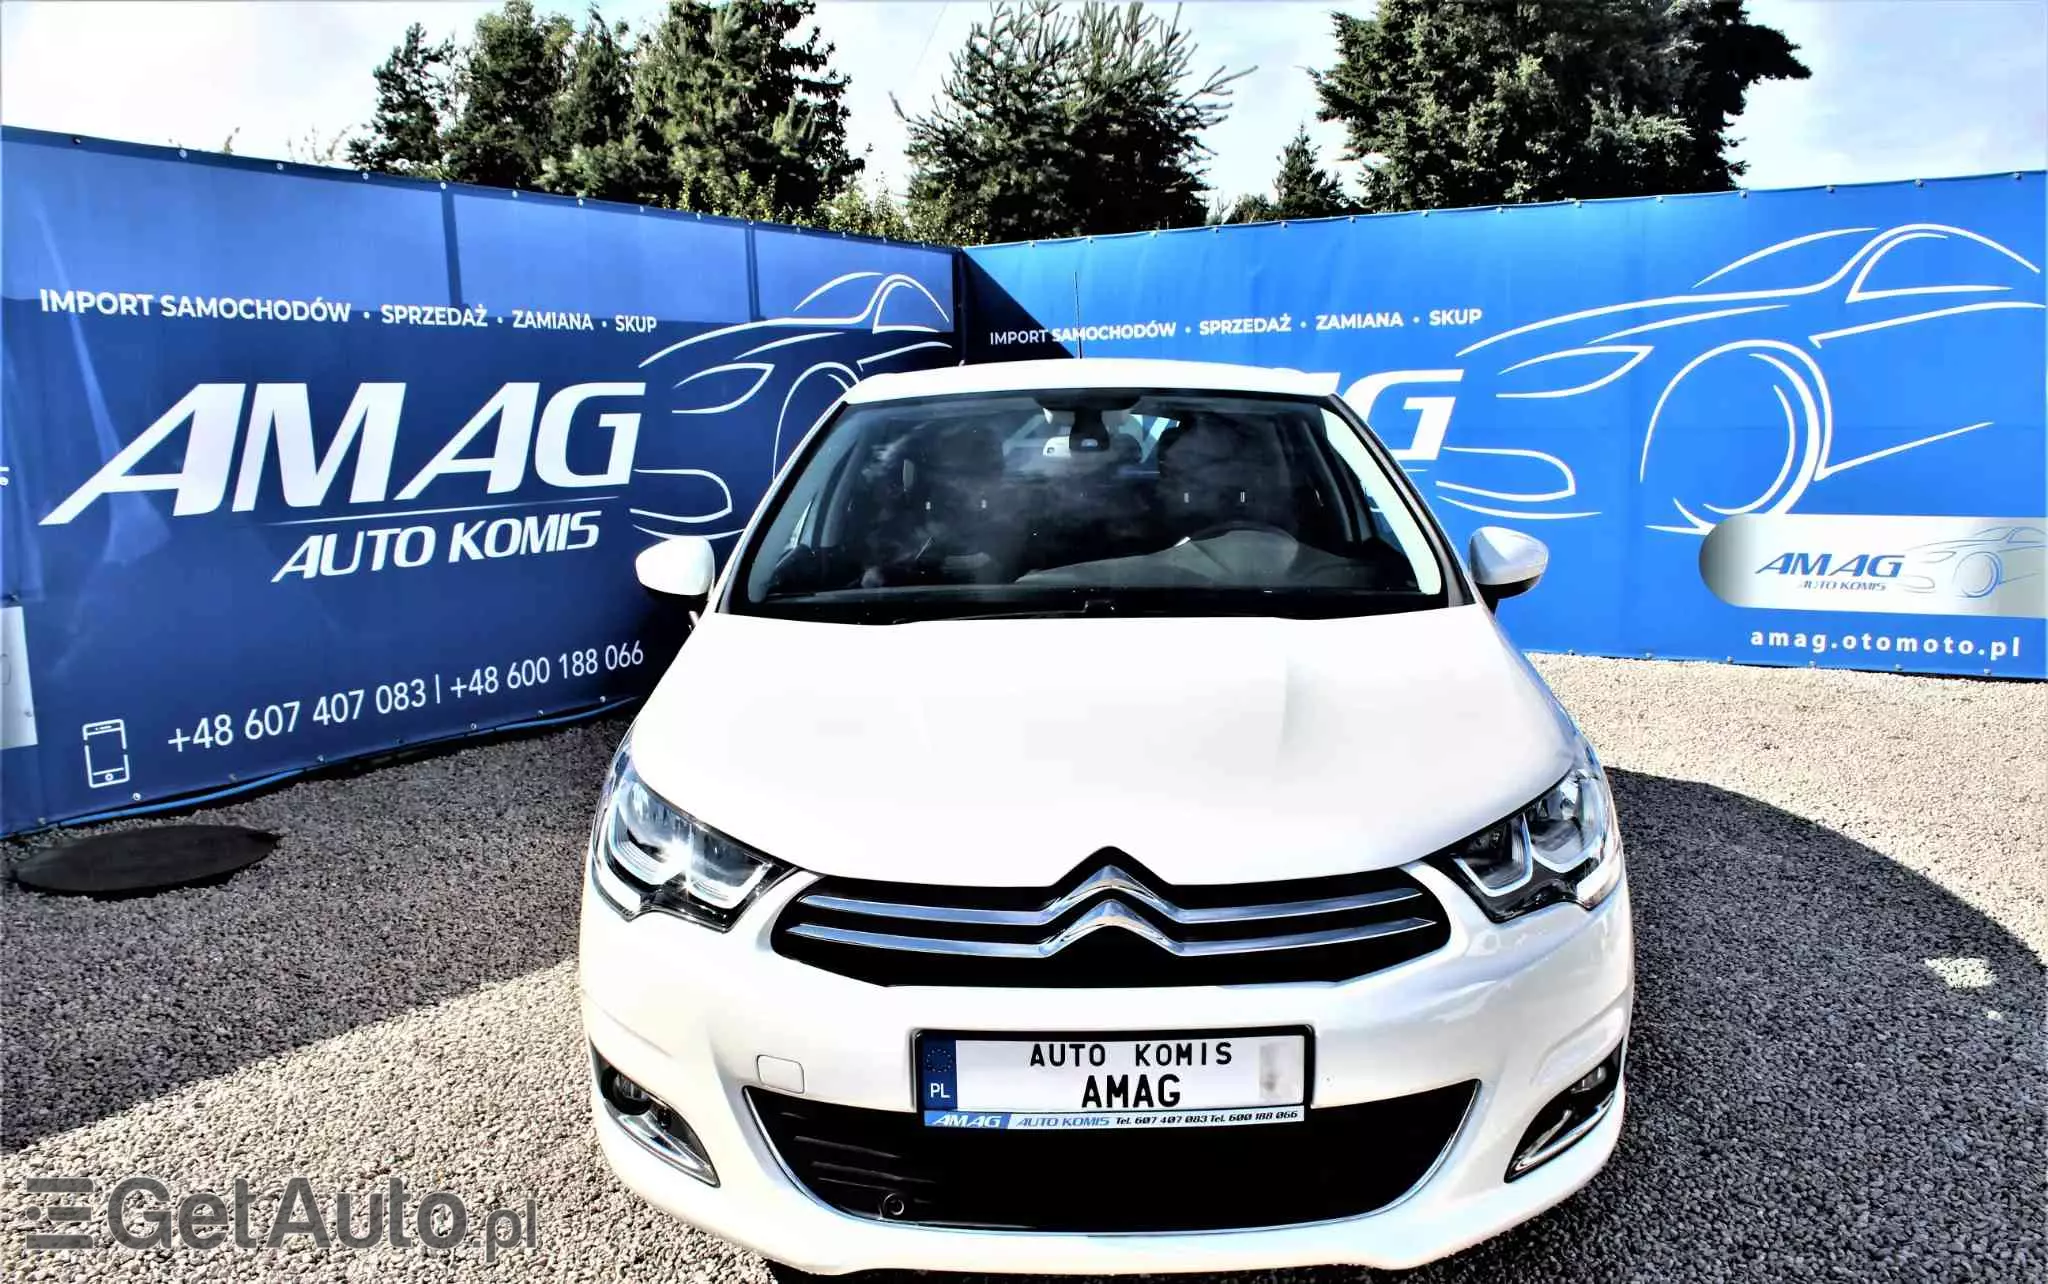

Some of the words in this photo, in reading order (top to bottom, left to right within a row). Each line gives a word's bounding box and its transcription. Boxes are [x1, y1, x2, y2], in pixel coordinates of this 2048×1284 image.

[40, 289, 154, 316] IMPORT
[161, 295, 350, 323] SAMOCHODÓW
[380, 303, 488, 327] SPRZEDAŻ
[512, 310, 594, 331] ZAMIANA
[615, 314, 658, 333] SKUP
[990, 329, 1048, 345] IMPORT
[1051, 320, 1177, 342] SAMOCHODÓW
[1199, 312, 1291, 336] SPRZEDAŻ
[1315, 312, 1404, 330] ZAMIANA
[1429, 308, 1483, 326] SKUP
[272, 522, 435, 583] AUTO
[448, 510, 602, 563] KOMIS
[1839, 581, 1887, 592] KOMIS
[1751, 630, 2021, 661] amag.otomoto.pl
[167, 714, 233, 753] +48
[244, 701, 301, 740] 607
[312, 690, 365, 726] 407
[375, 678, 427, 715] 083
[450, 666, 499, 699] +48
[506, 657, 549, 689] 600
[559, 648, 599, 680] 188
[604, 640, 644, 671] 066
[1029, 1043, 1106, 1067] AUTO
[1135, 1041, 1232, 1066] KOMIS
[930, 1083, 950, 1099] PL
[1081, 1074, 1182, 1108] AMAG
[1016, 1117, 1058, 1127] AUTO
[1062, 1116, 1110, 1127] KOMIS
[1135, 1116, 1158, 1125] 607
[1160, 1115, 1182, 1124] 407
[1185, 1114, 1208, 1123] 083
[1228, 1113, 1252, 1122] 600
[1255, 1112, 1273, 1121] 188
[1275, 1110, 1298, 1119] 066
